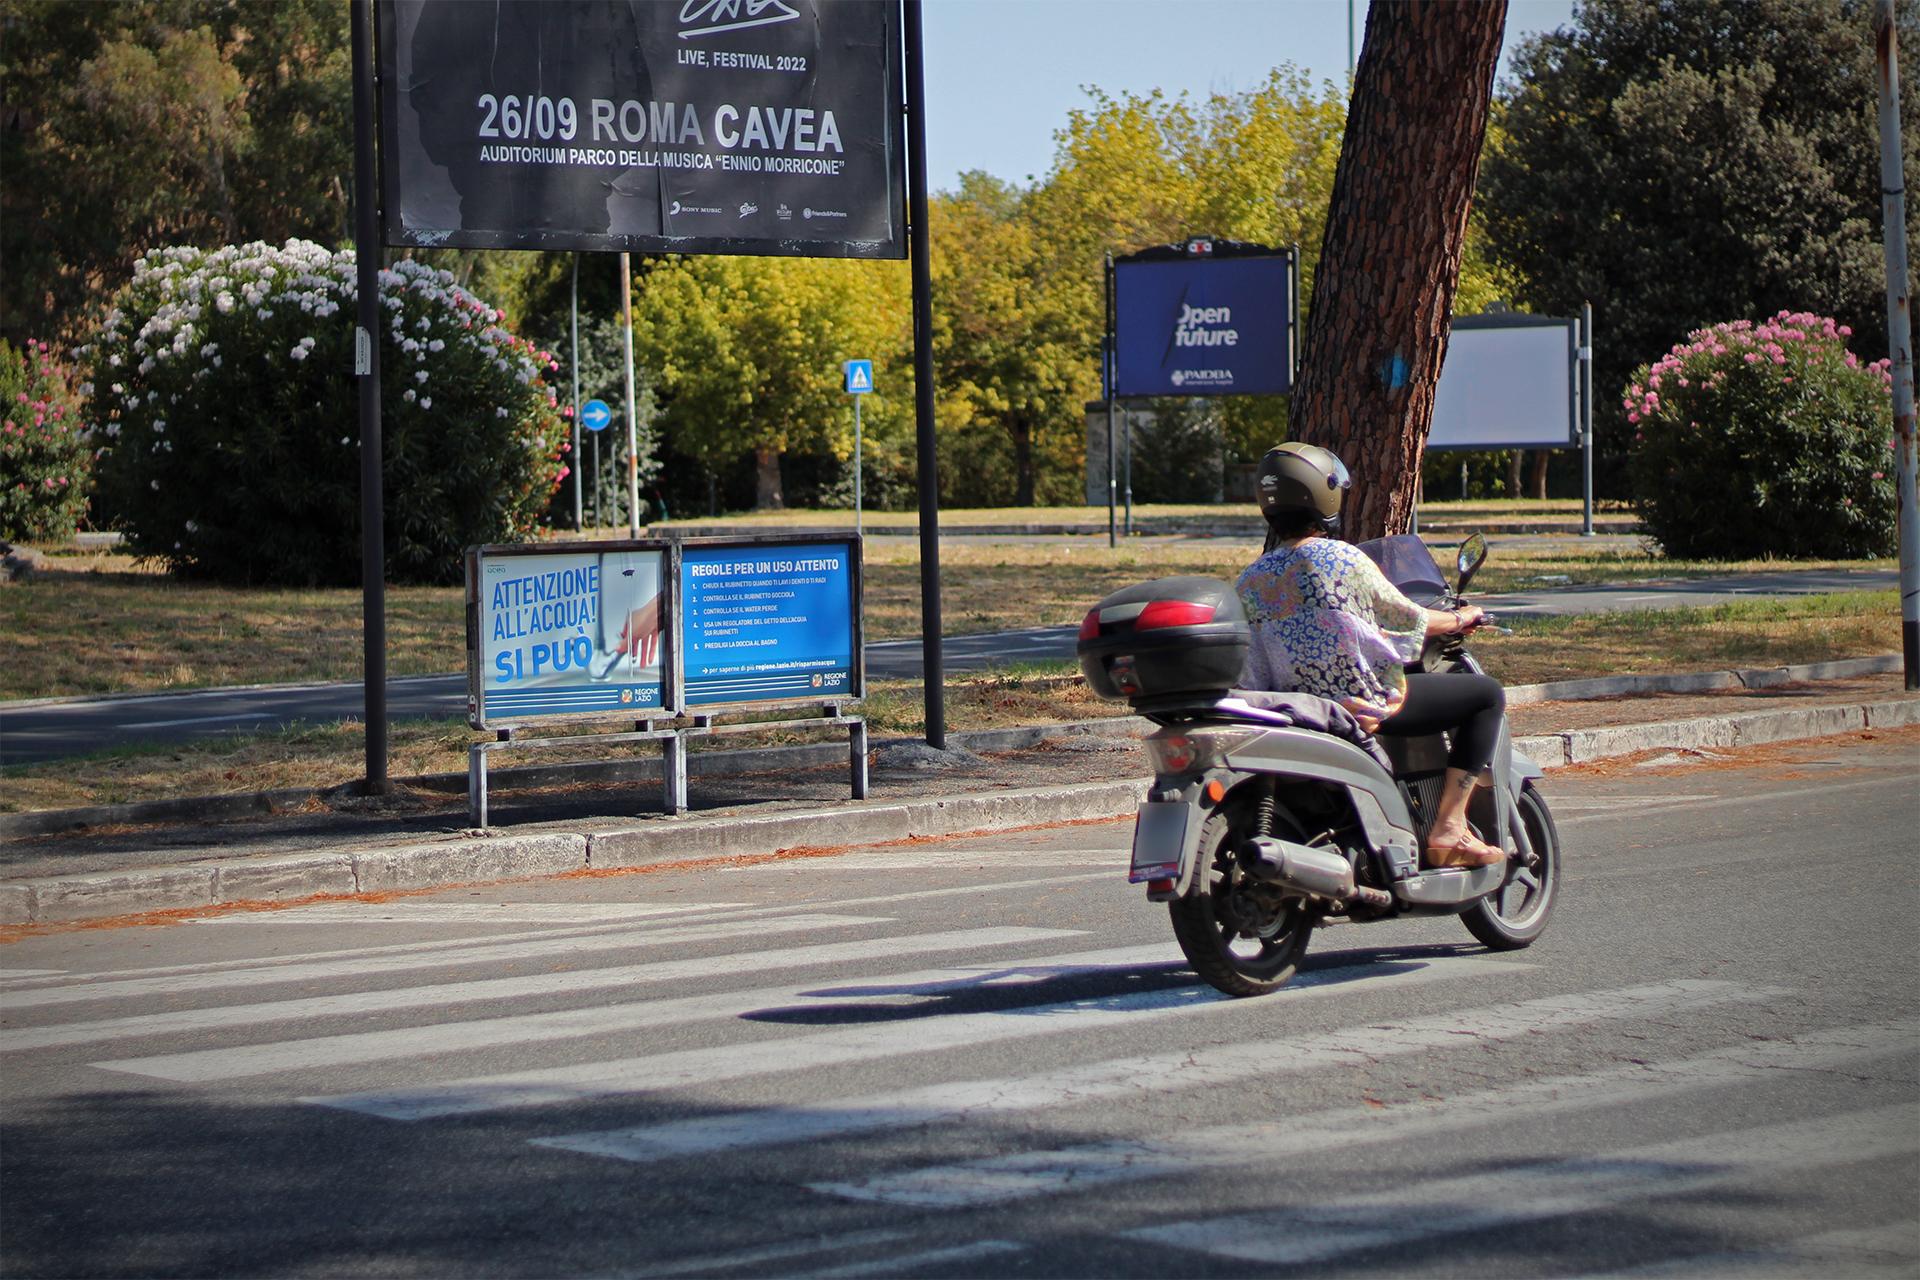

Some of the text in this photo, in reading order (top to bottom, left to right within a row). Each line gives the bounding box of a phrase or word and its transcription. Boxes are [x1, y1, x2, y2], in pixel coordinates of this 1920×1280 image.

[677, 49, 806, 71] LIVE, FESTIVAL 2022
[478, 94, 844, 153] 26/09 ROMA CAVEA
[480, 145, 566, 164] AUDITORIUM
[569, 149, 616, 166] PARCO
[619, 150, 661, 167] DELLA
[663, 152, 713, 169] MUSICA
[1175, 324, 1239, 347] future
[691, 558, 839, 577] REGOLE PER UN USO ATTENTO
[492, 565, 600, 611] ATTENZIONE
[702, 594, 732, 602] CONTROLLA
[703, 607, 732, 615] CONTROLLA
[495, 648, 524, 683] SI
[532, 625, 593, 677] PUÒ
[634, 687, 659, 696] REGIONE
[824, 679, 841, 687] LAZIO
[634, 694, 652, 702] LAZIO
